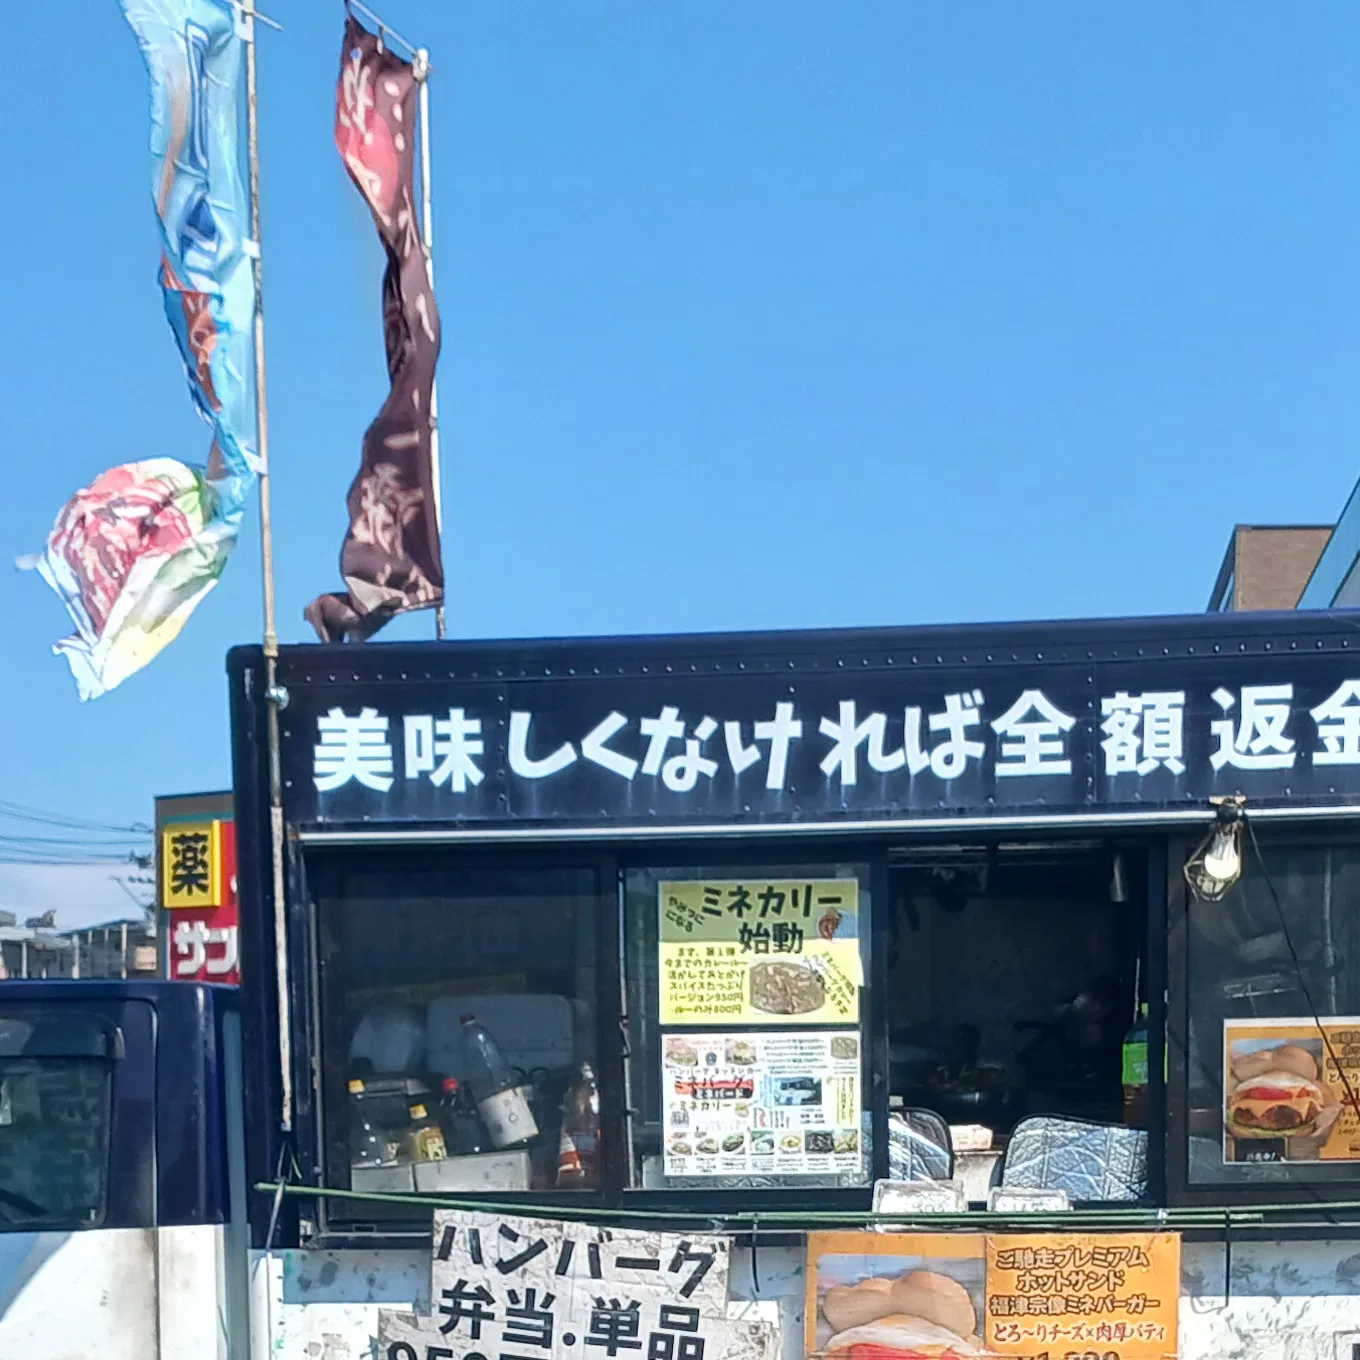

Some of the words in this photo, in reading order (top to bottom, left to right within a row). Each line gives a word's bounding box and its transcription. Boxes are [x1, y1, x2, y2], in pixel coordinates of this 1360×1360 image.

[171, 832, 209, 896] 薬
[701, 884, 842, 918] ミネカリー
[739, 922, 804, 955] 始動
[437, 1222, 726, 1299] ハンバーグ
[995, 1245, 1150, 1270] ご馳走プレミアム
[1015, 1268, 1126, 1293] ホットサンド
[989, 1294, 1161, 1316] 福津宗像ミネバーガー
